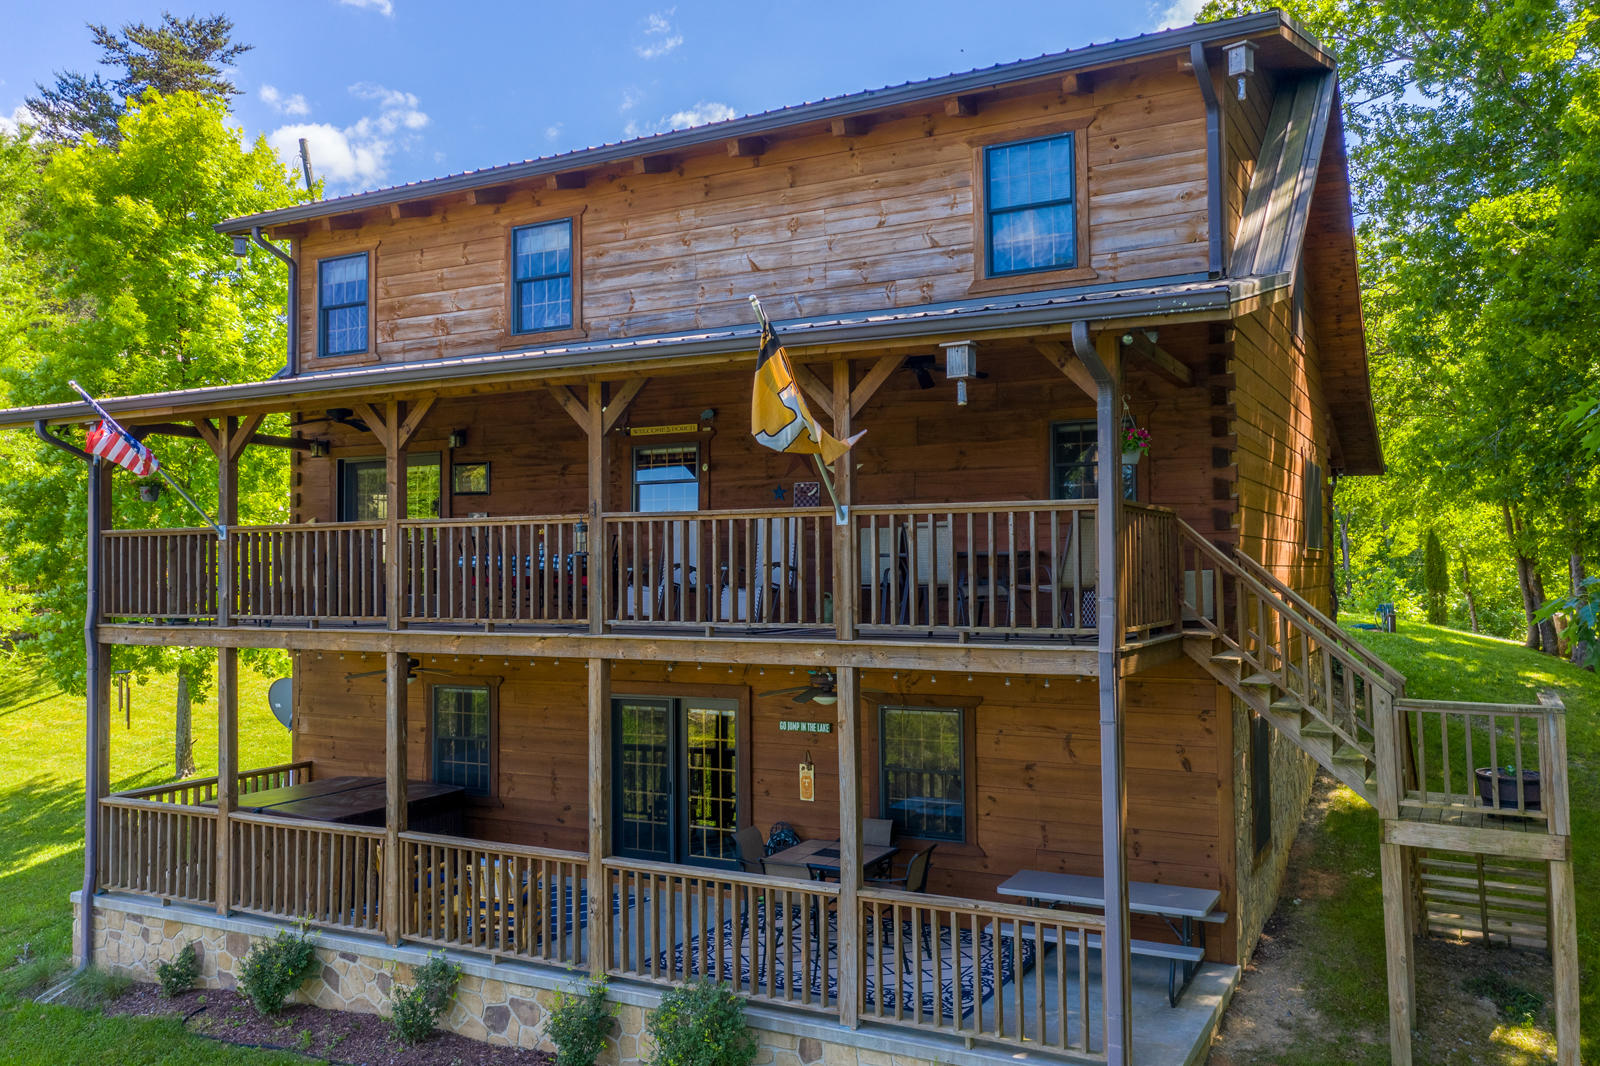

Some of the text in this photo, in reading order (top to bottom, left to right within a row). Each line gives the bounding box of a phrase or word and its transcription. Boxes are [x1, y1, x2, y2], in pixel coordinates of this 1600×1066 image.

[779, 720, 830, 733] GO JUMP IN THE LAKE
